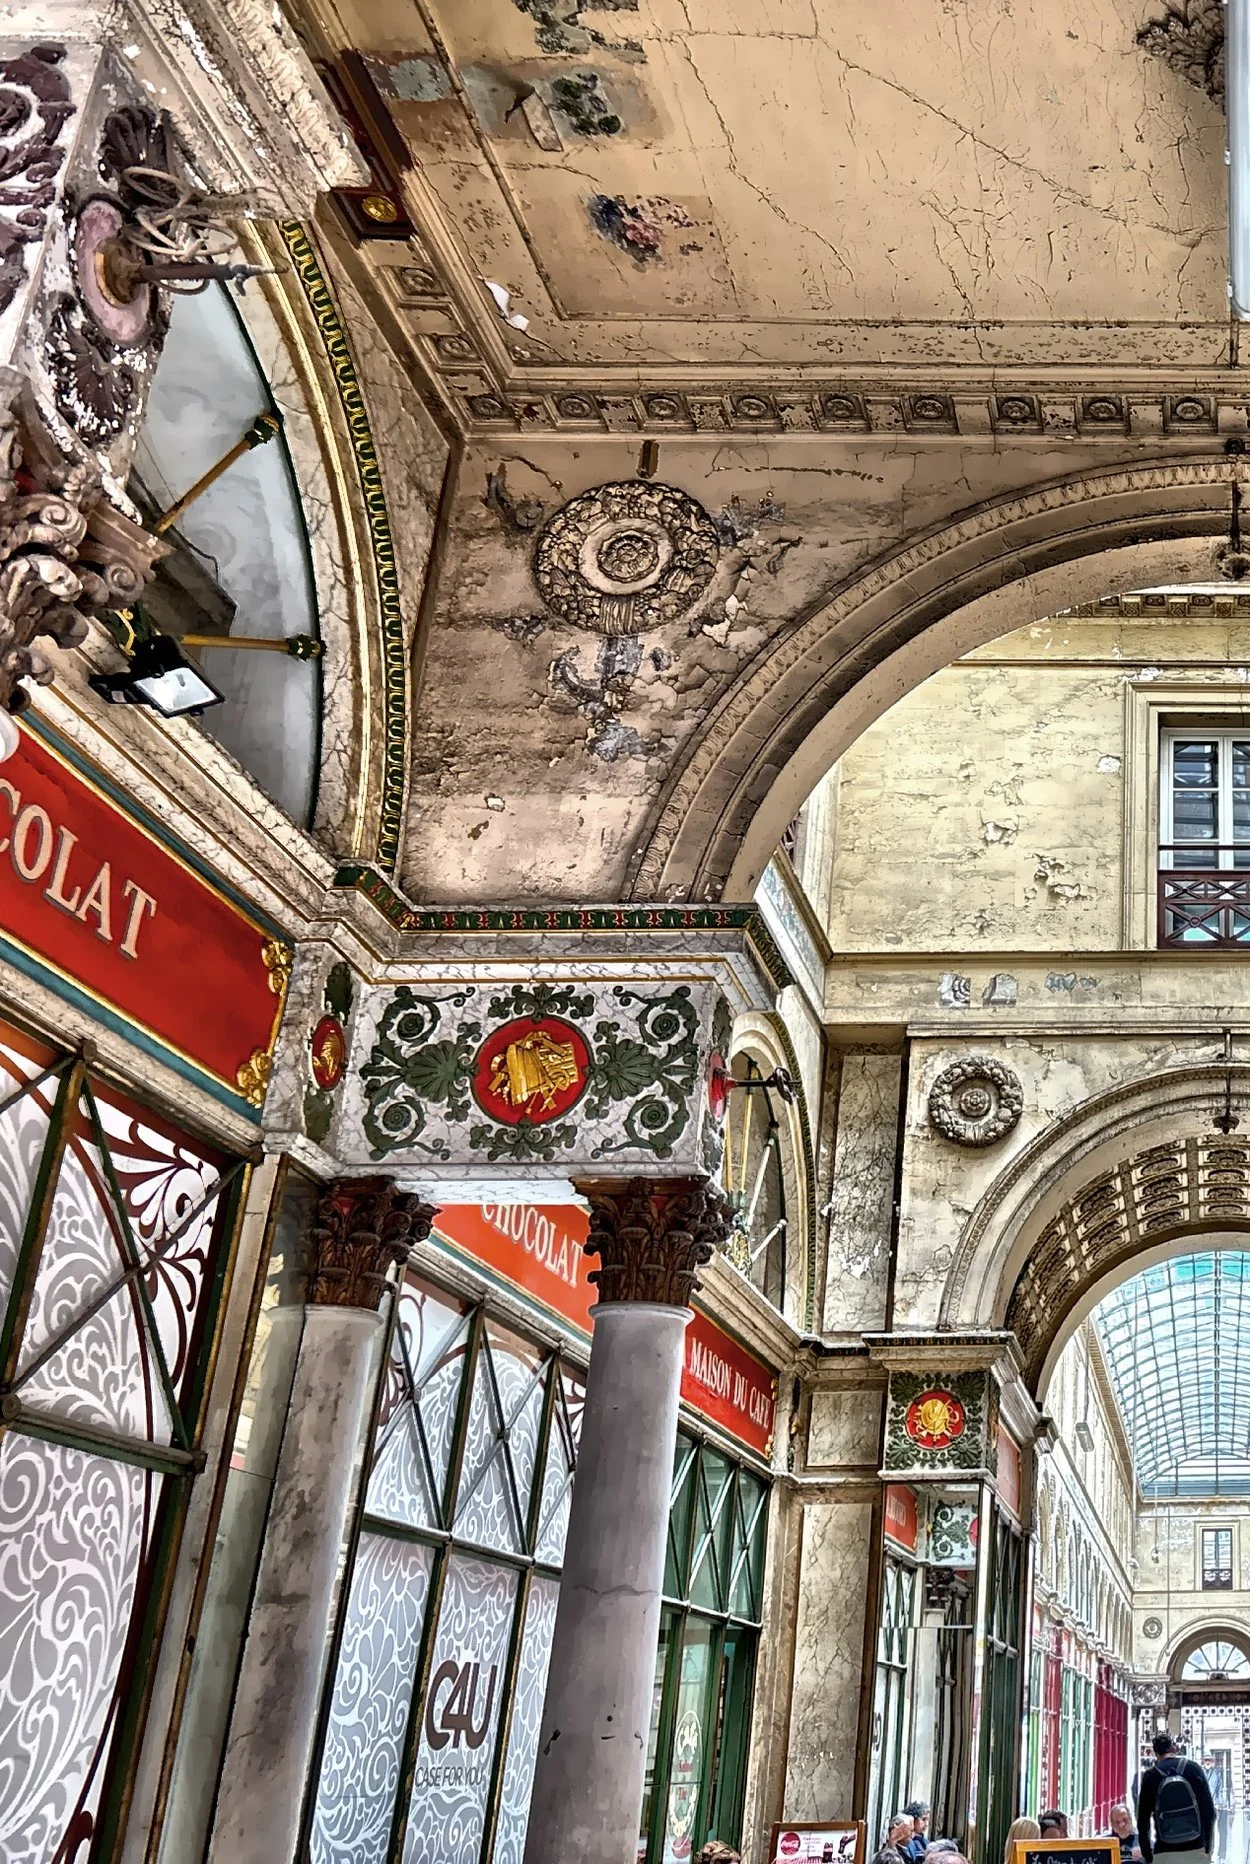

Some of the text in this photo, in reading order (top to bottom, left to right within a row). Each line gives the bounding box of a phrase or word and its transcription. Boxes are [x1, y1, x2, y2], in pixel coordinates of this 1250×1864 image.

[689, 1337, 732, 1400] MAISON
[732, 1371, 748, 1413] DU
[425, 1660, 498, 1751] C4U
[415, 1766, 484, 1788] CASE FOR YOU
